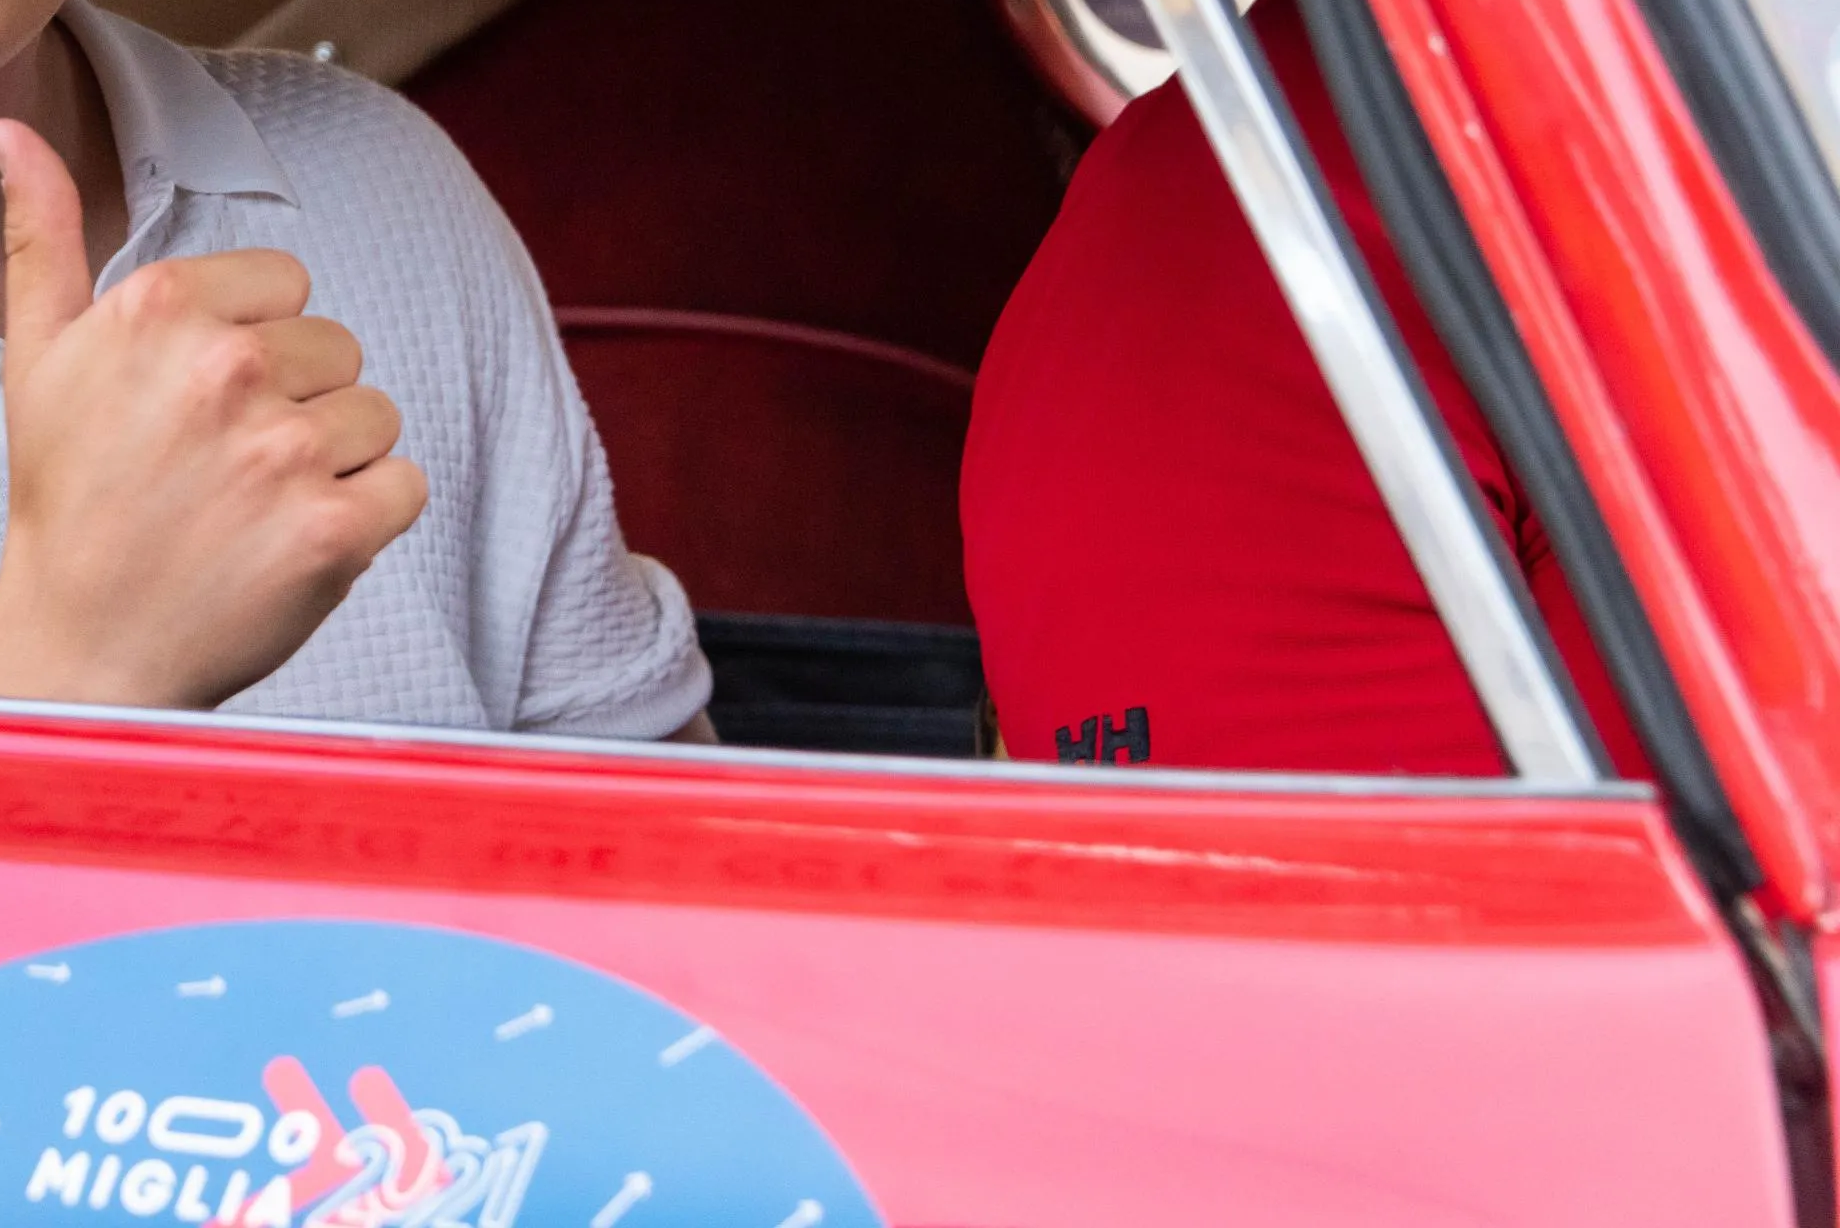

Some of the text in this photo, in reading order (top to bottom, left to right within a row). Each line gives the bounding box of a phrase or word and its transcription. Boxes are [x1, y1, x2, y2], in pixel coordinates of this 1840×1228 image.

[1055, 707, 1151, 768] HH
[62, 1084, 322, 1166] 1000
[25, 1147, 293, 1228] MIGLIA
